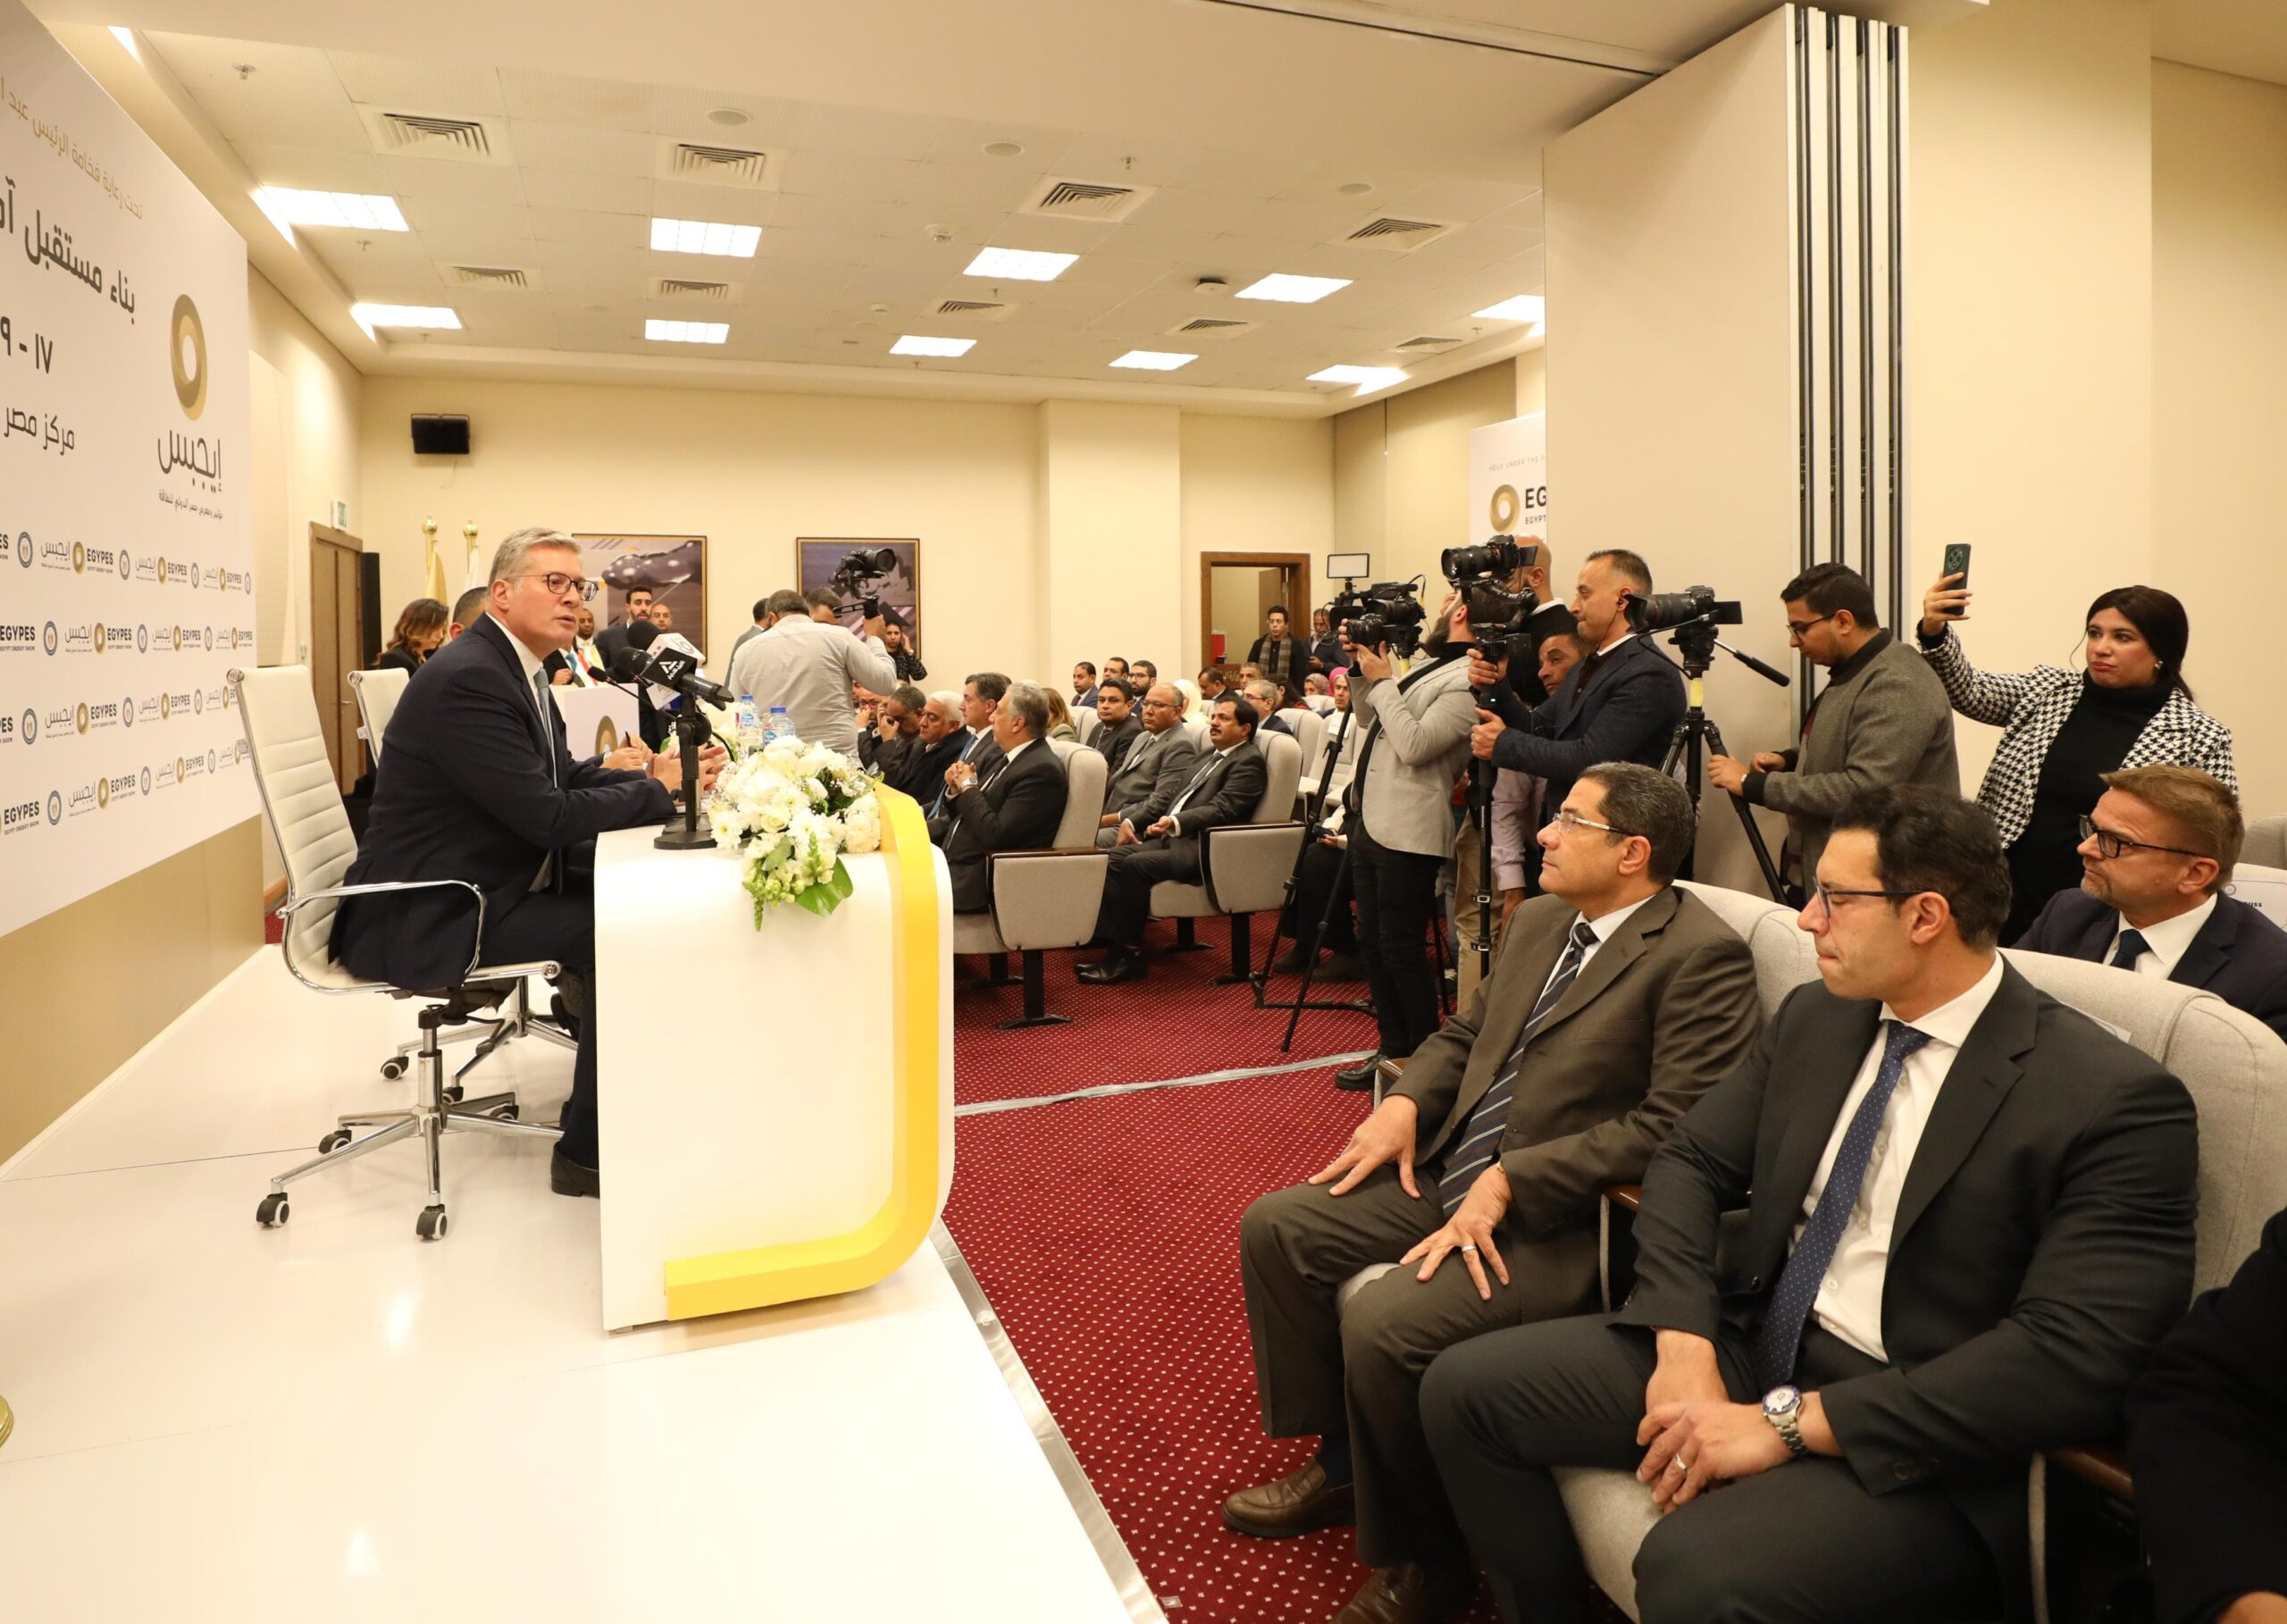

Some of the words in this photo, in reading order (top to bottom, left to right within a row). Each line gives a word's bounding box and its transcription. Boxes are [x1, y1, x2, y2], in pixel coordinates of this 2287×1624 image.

[9, 91, 29, 121] عبد
[32, 118, 69, 157] الرئيس
[72, 143, 100, 183] فخامة
[103, 172, 122, 210] رعاية
[25, 209, 102, 293] مستقبل
[110, 270, 134, 325] بناء
[36, 333, 53, 373] ١٧
[4, 407, 37, 438] مصر
[43, 413, 74, 456] مركز
[87, 548, 113, 565] EGYPES
[168, 562, 187, 576] EGYPES
[0, 625, 36, 641] EGYPES
[107, 627, 132, 641] EGYPES
[182, 629, 201, 640] EGYPES
[90, 703, 117, 720] EGYPES
[171, 694, 190, 707] EGYPES
[0, 716, 13, 733] ES
[186, 755, 205, 771] EGYPES
[110, 774, 136, 793] EGYPES
[4, 800, 40, 825] EGYPES
